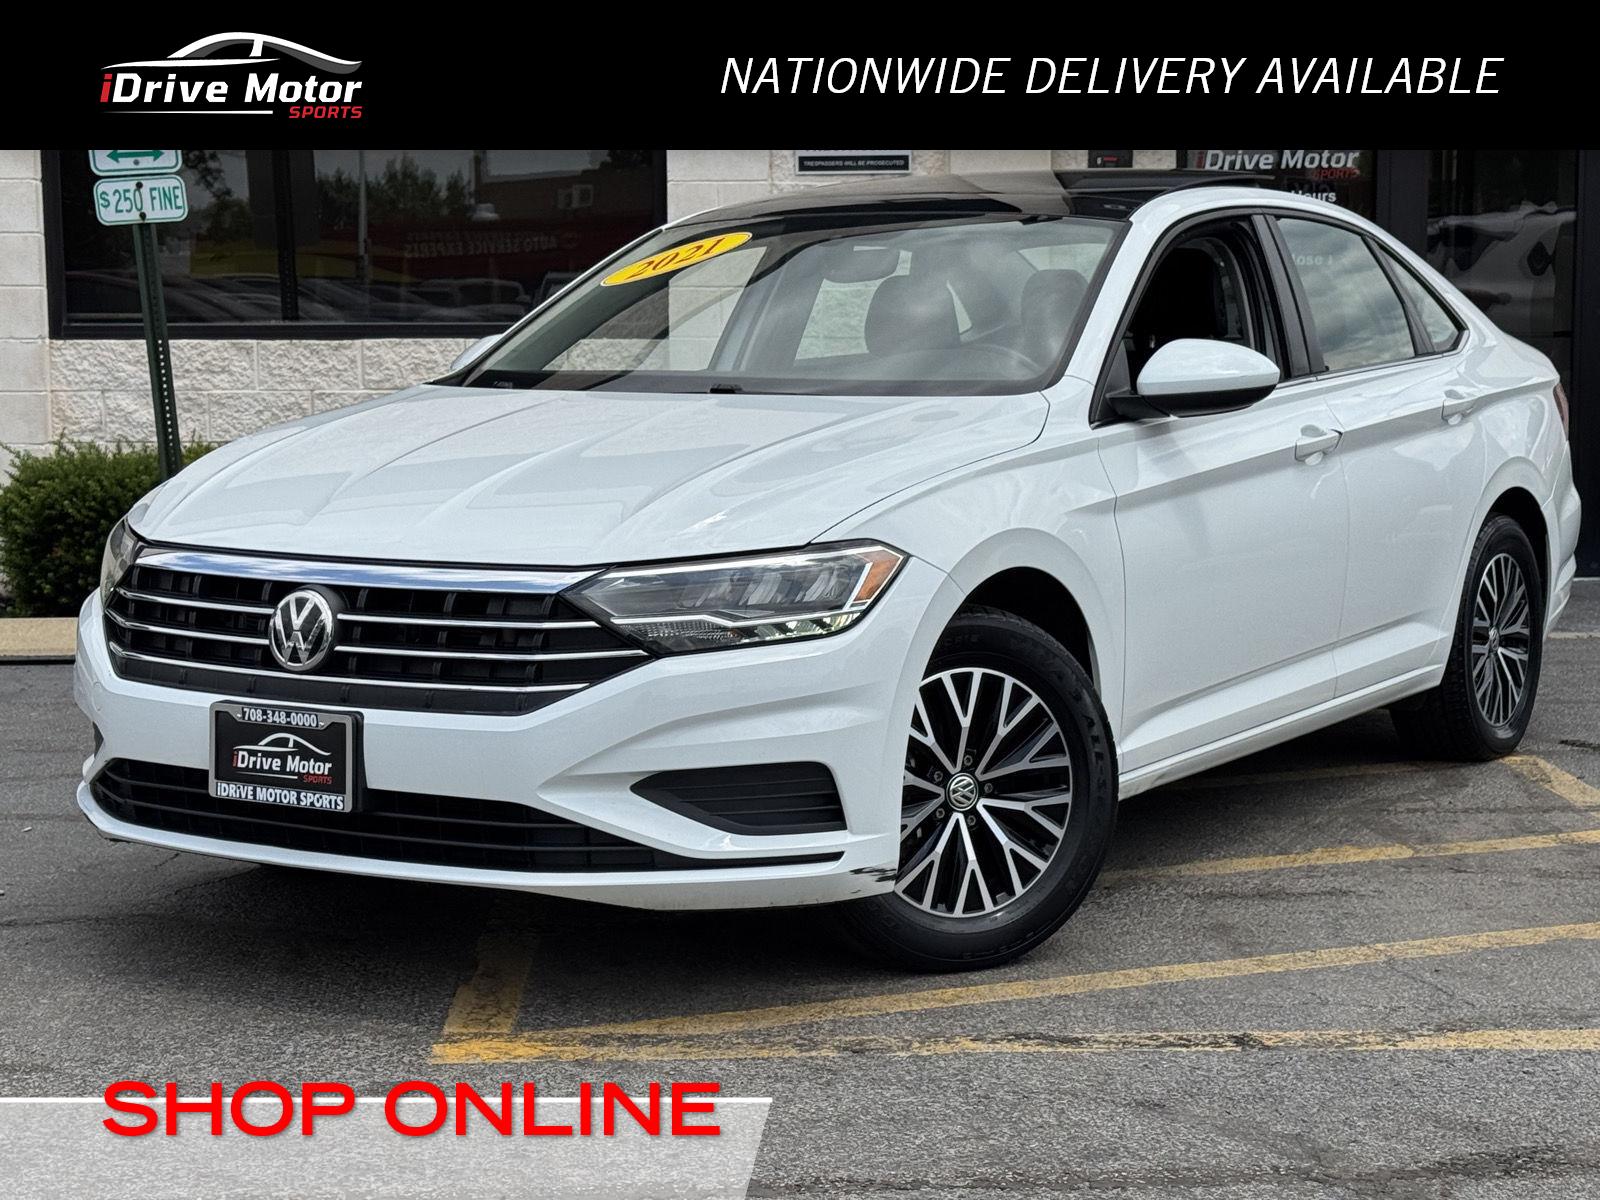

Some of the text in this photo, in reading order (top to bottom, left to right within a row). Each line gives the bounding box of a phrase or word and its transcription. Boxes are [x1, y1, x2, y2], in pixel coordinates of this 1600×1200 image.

[1281, 150, 1360, 169] Motor
[99, 186, 183, 214] $250 FINE
[614, 237, 726, 281] 2021
[243, 707, 318, 728] 708-348-0000
[232, 750, 332, 776] iDrive Motor
[303, 774, 333, 785] SPORTS
[256, 787, 298, 805] MOTOR
[300, 792, 344, 810] SPORTS
